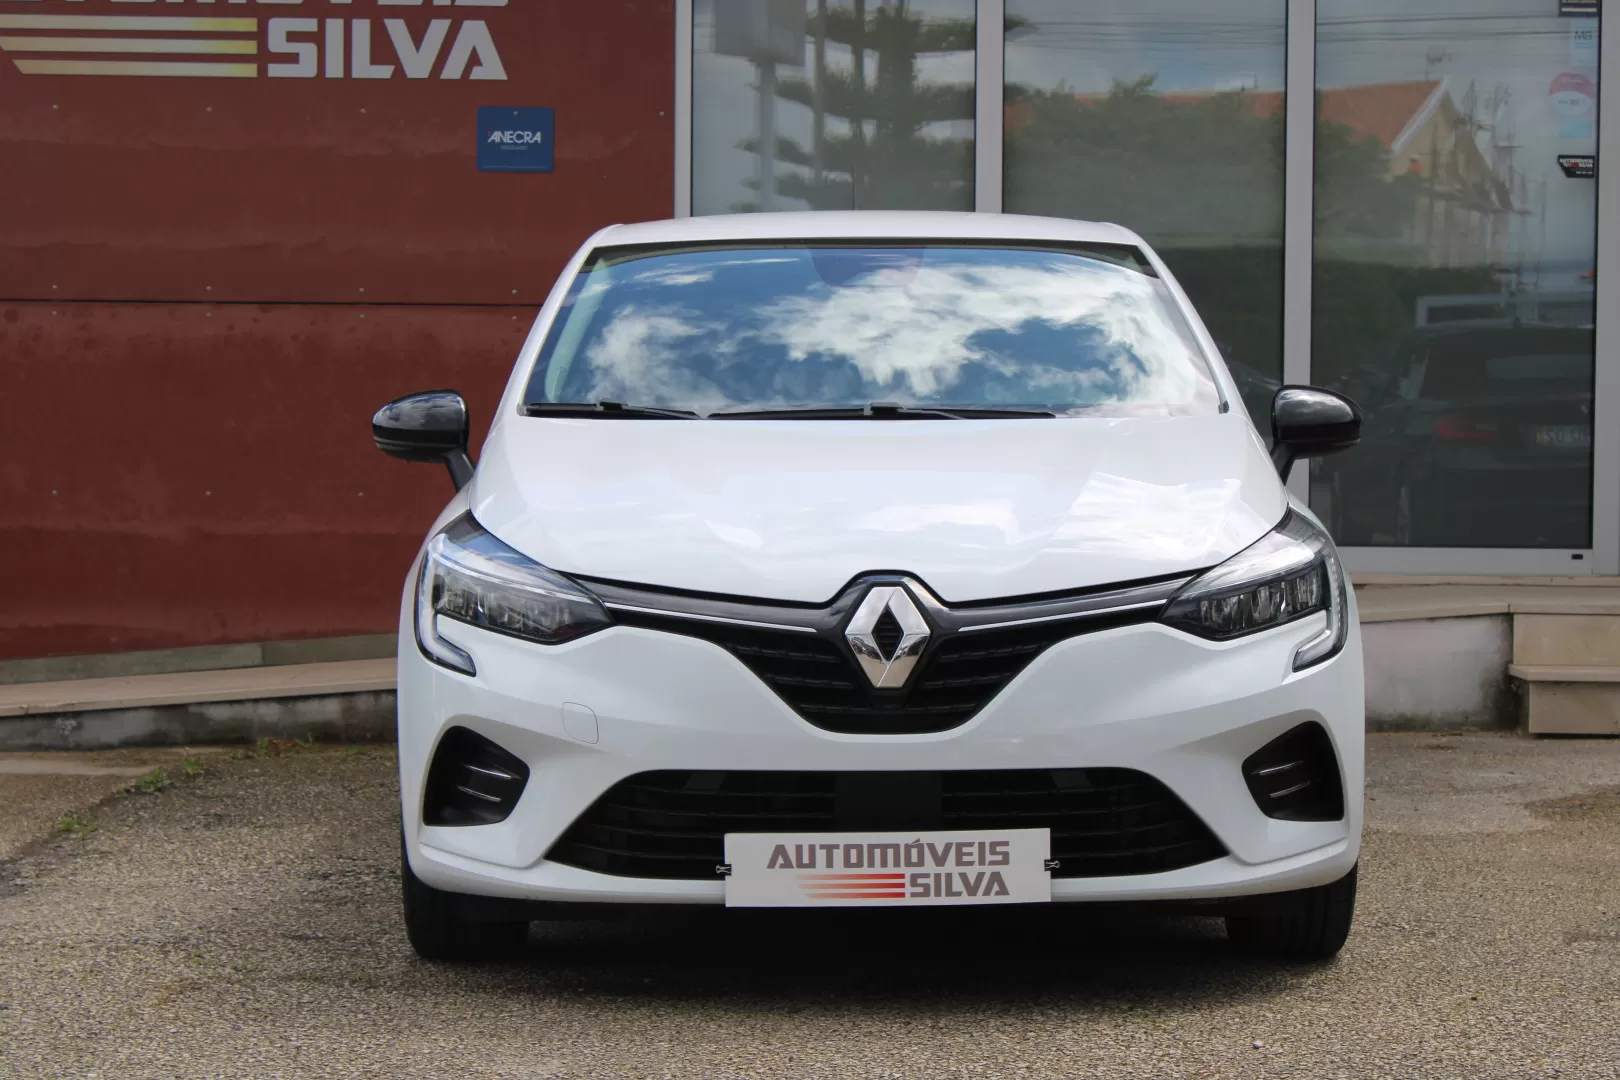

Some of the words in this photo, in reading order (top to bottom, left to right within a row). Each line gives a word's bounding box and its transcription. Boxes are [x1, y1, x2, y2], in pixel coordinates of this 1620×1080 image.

[267, 17, 509, 80] SILVA
[487, 130, 542, 143] ANECRA
[766, 838, 1011, 869] AUTOMÓVEIS
[909, 871, 1011, 898] SILVA
